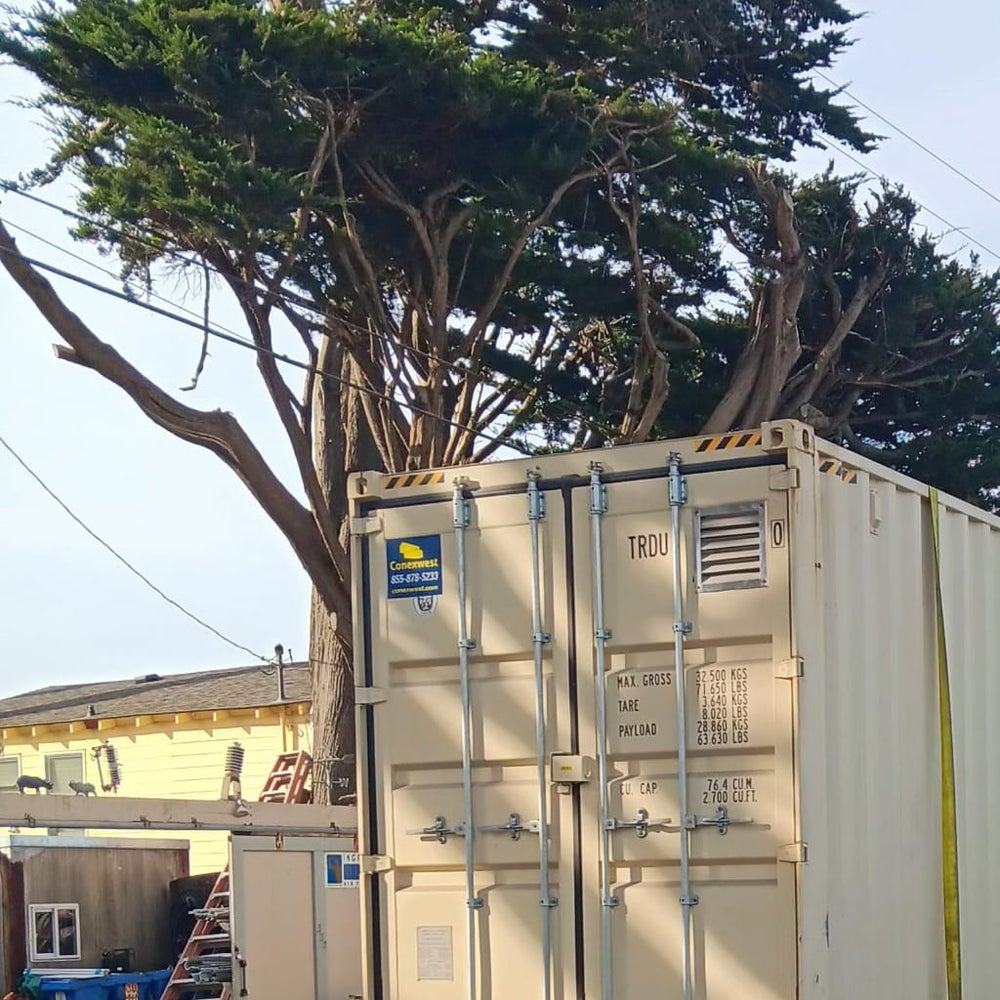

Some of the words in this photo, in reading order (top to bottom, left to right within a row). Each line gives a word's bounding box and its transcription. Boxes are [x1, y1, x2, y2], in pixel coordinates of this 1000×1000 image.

[627, 532, 669, 560] TRDU
[389, 558, 438, 570] Conexwest
[617, 675, 639, 689] MAX.
[642, 673, 672, 687] GROSS
[730, 668, 748, 680] KGS
[731, 681, 748, 693] LBS
[618, 699, 640, 712] TARE
[731, 694, 748, 706] KGS
[702, 707, 727, 720] 8.020
[731, 706, 748, 718] LBS
[619, 723, 657, 737] PAYLOAD
[697, 719, 728, 733] 28.860
[732, 719, 749, 731] KGS
[697, 732, 728, 745] 63.630
[732, 731, 749, 744] LBS
[707, 778, 728, 791] 76.4
[703, 791, 728, 804] 2.700
